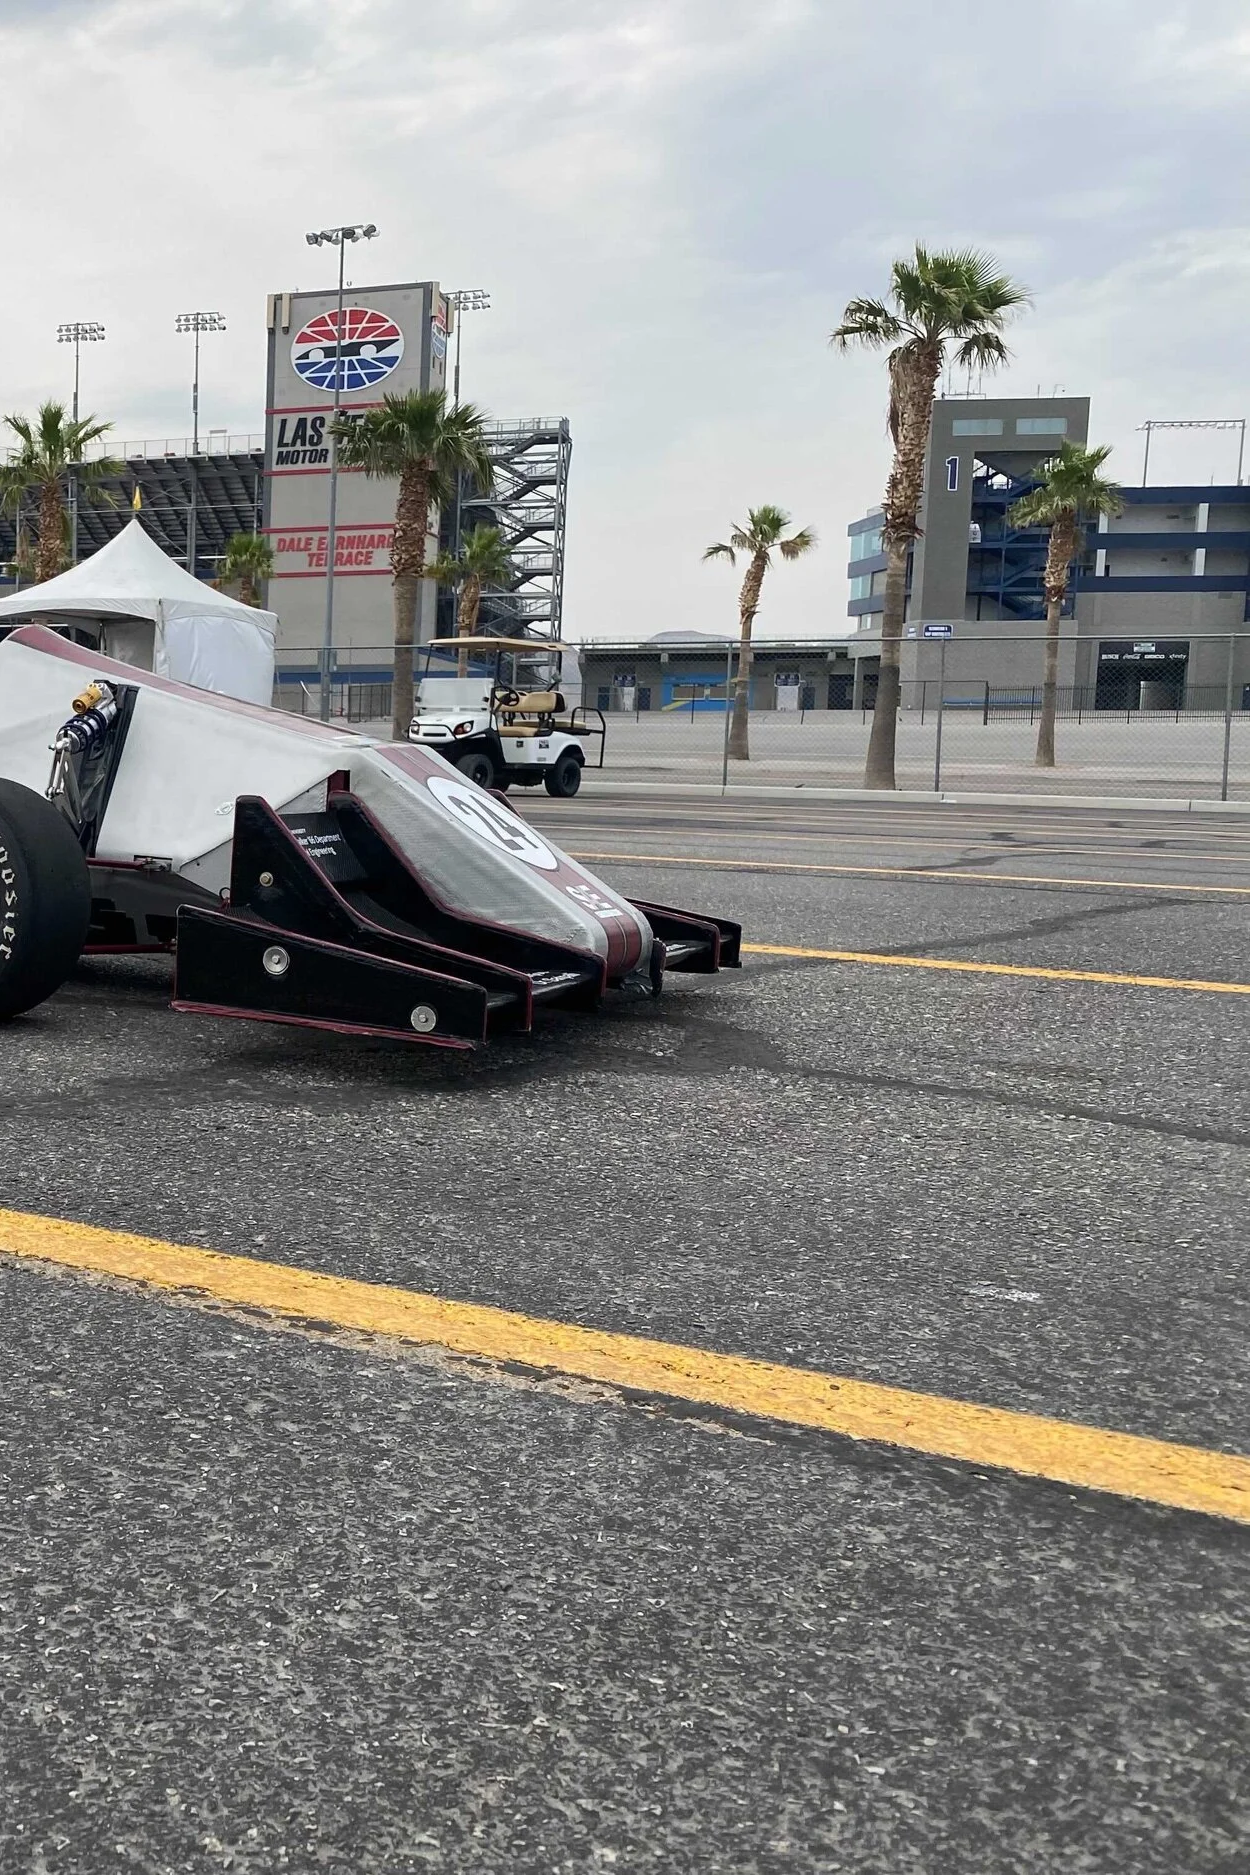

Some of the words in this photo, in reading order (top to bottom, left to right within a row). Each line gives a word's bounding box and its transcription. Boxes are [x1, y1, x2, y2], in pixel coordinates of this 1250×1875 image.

[276, 415, 326, 449] LAS
[275, 448, 329, 466] MOTOR
[945, 456, 959, 491] 1
[276, 536, 314, 553] DALE
[316, 533, 395, 552] ERNHAR
[307, 551, 374, 567] TERACE
